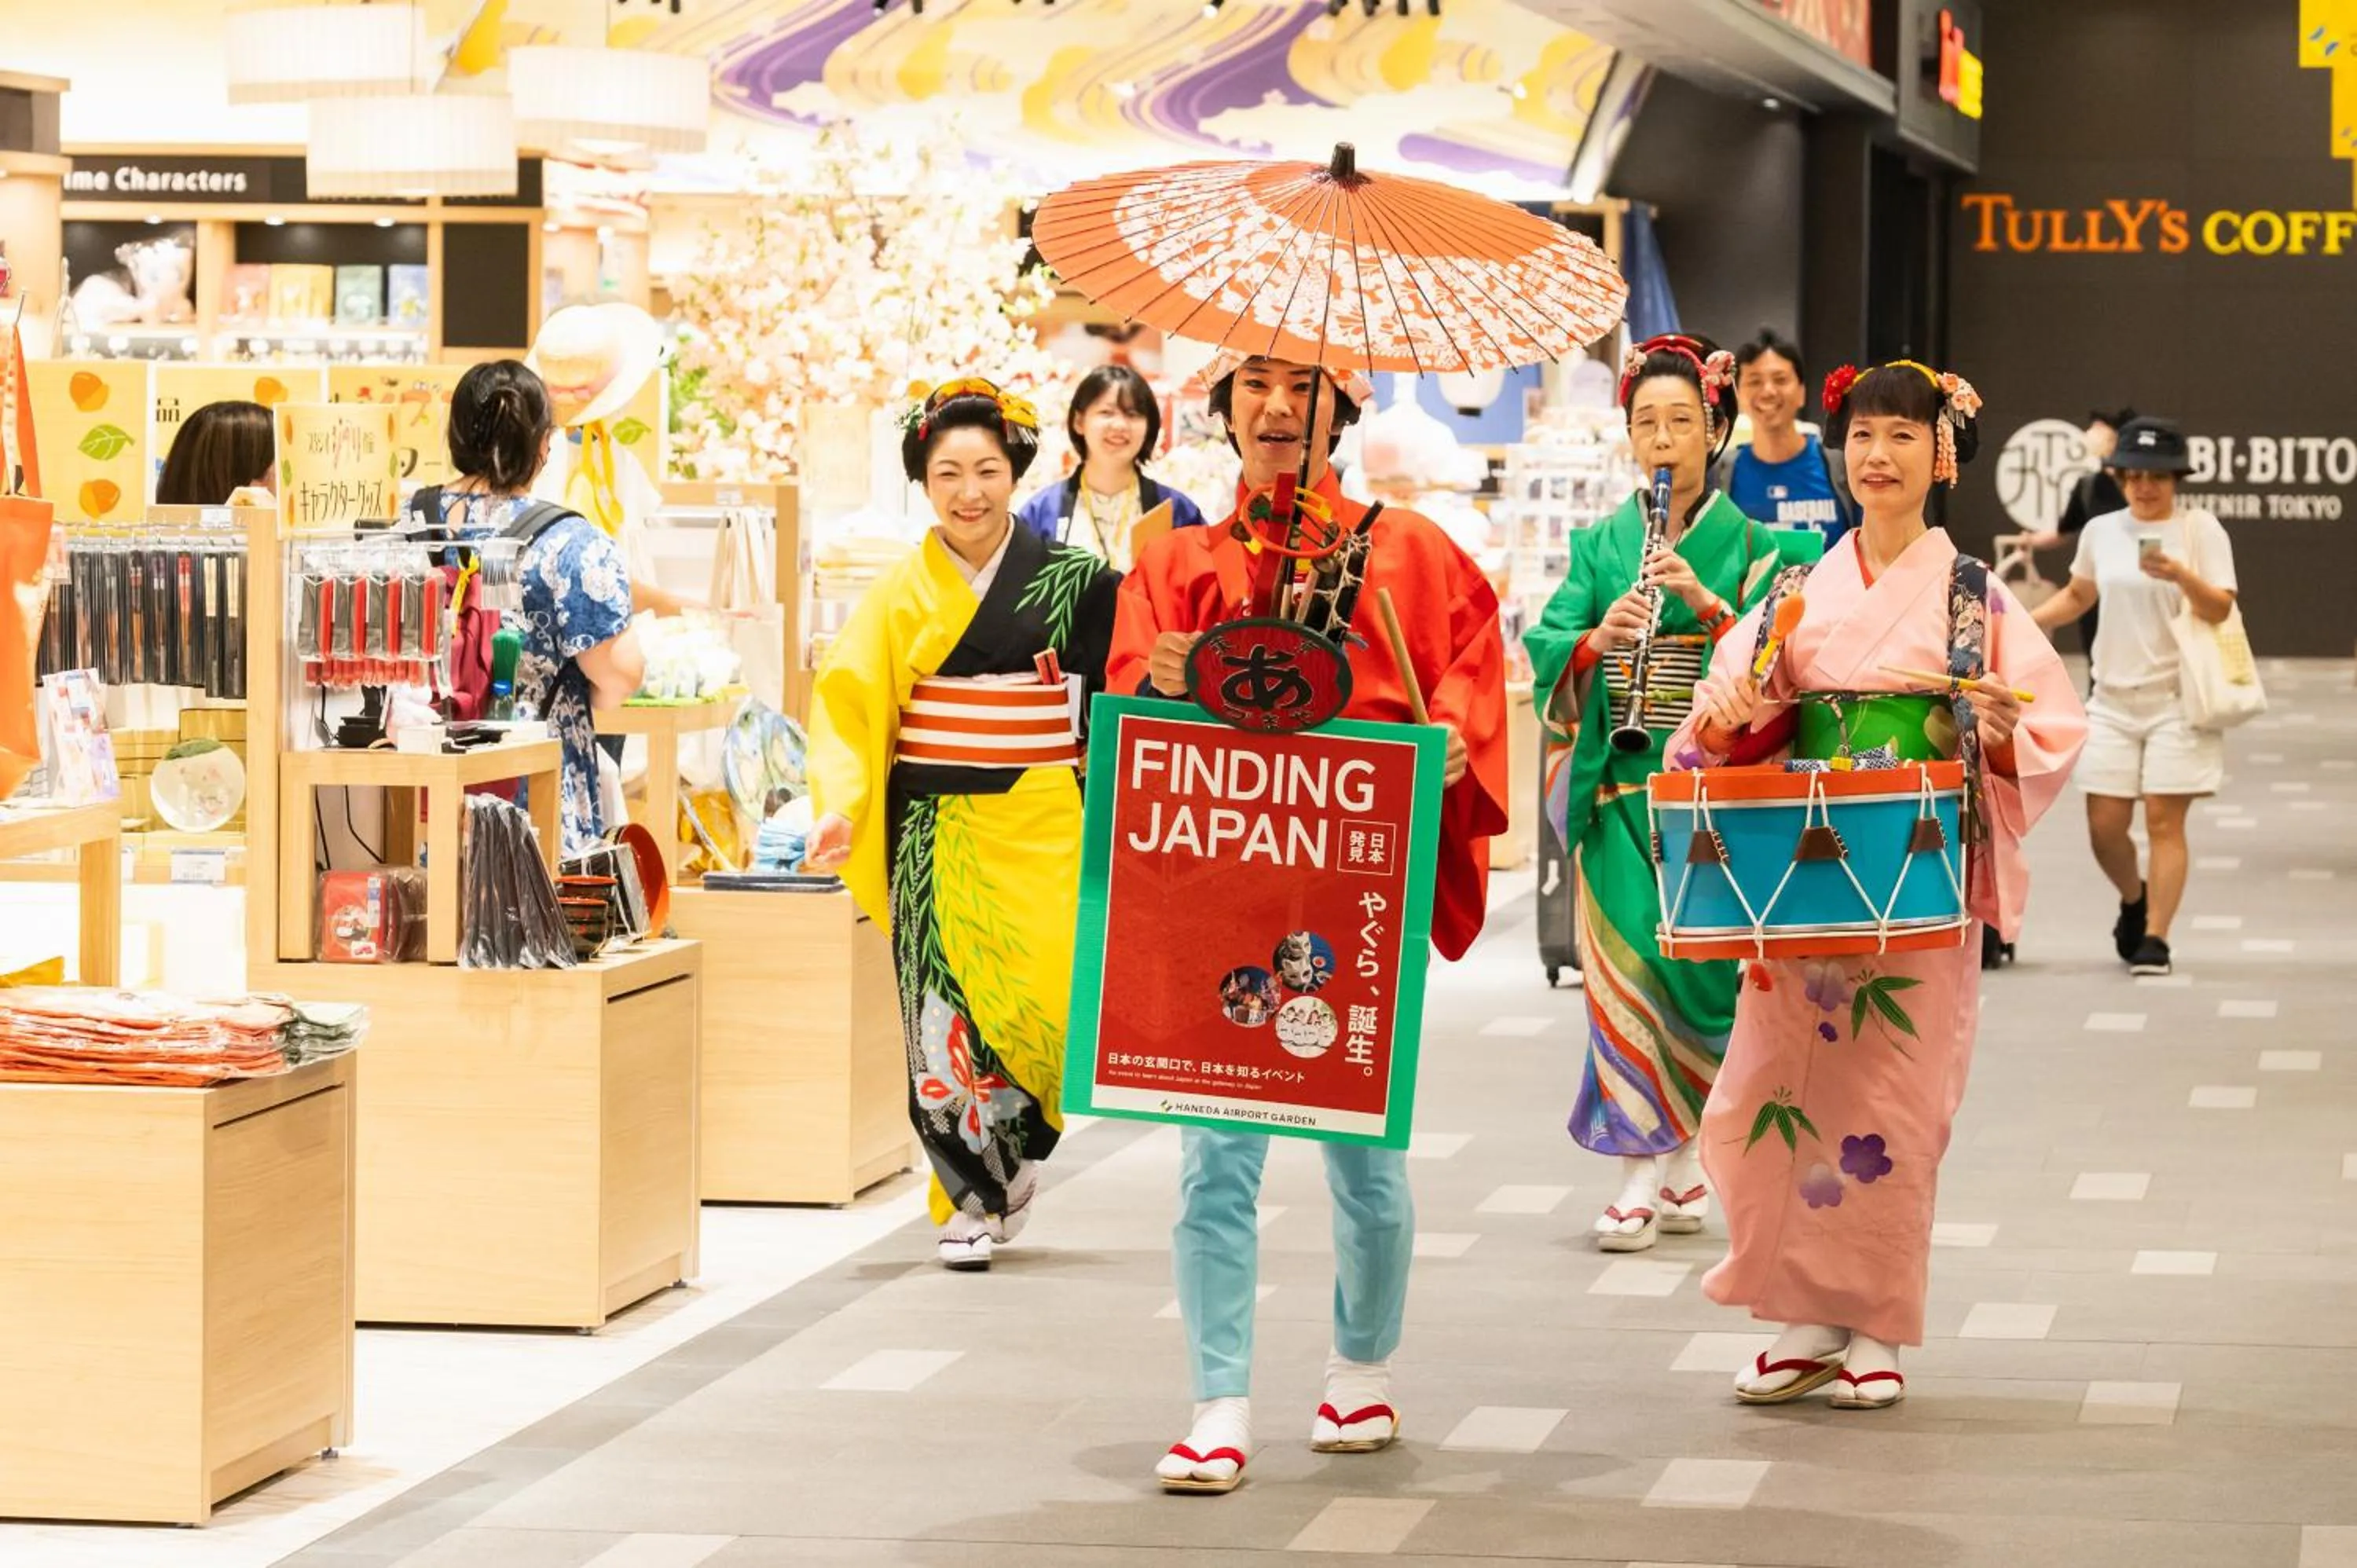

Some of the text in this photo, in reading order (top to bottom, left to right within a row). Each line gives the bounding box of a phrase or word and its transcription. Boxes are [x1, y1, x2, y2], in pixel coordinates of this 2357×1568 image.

[115, 167, 247, 192] Characters
[299, 478, 383, 522] キャラクターグッズ
[2267, 495, 2343, 521] TOKYO
[1219, 643, 1314, 712] あ
[1132, 738, 1376, 812] FINDING
[1127, 801, 1328, 869] JAPAN
[1347, 830, 1366, 863] 発見
[1368, 831, 1386, 864] 日本
[1344, 891, 1387, 1077] やぐら、誕生。
[1108, 1052, 1306, 1083] 日本の玄関口で、日本を知るイベント
[1175, 1103, 1317, 1127] HANEDA AIRPORT GARDEN
